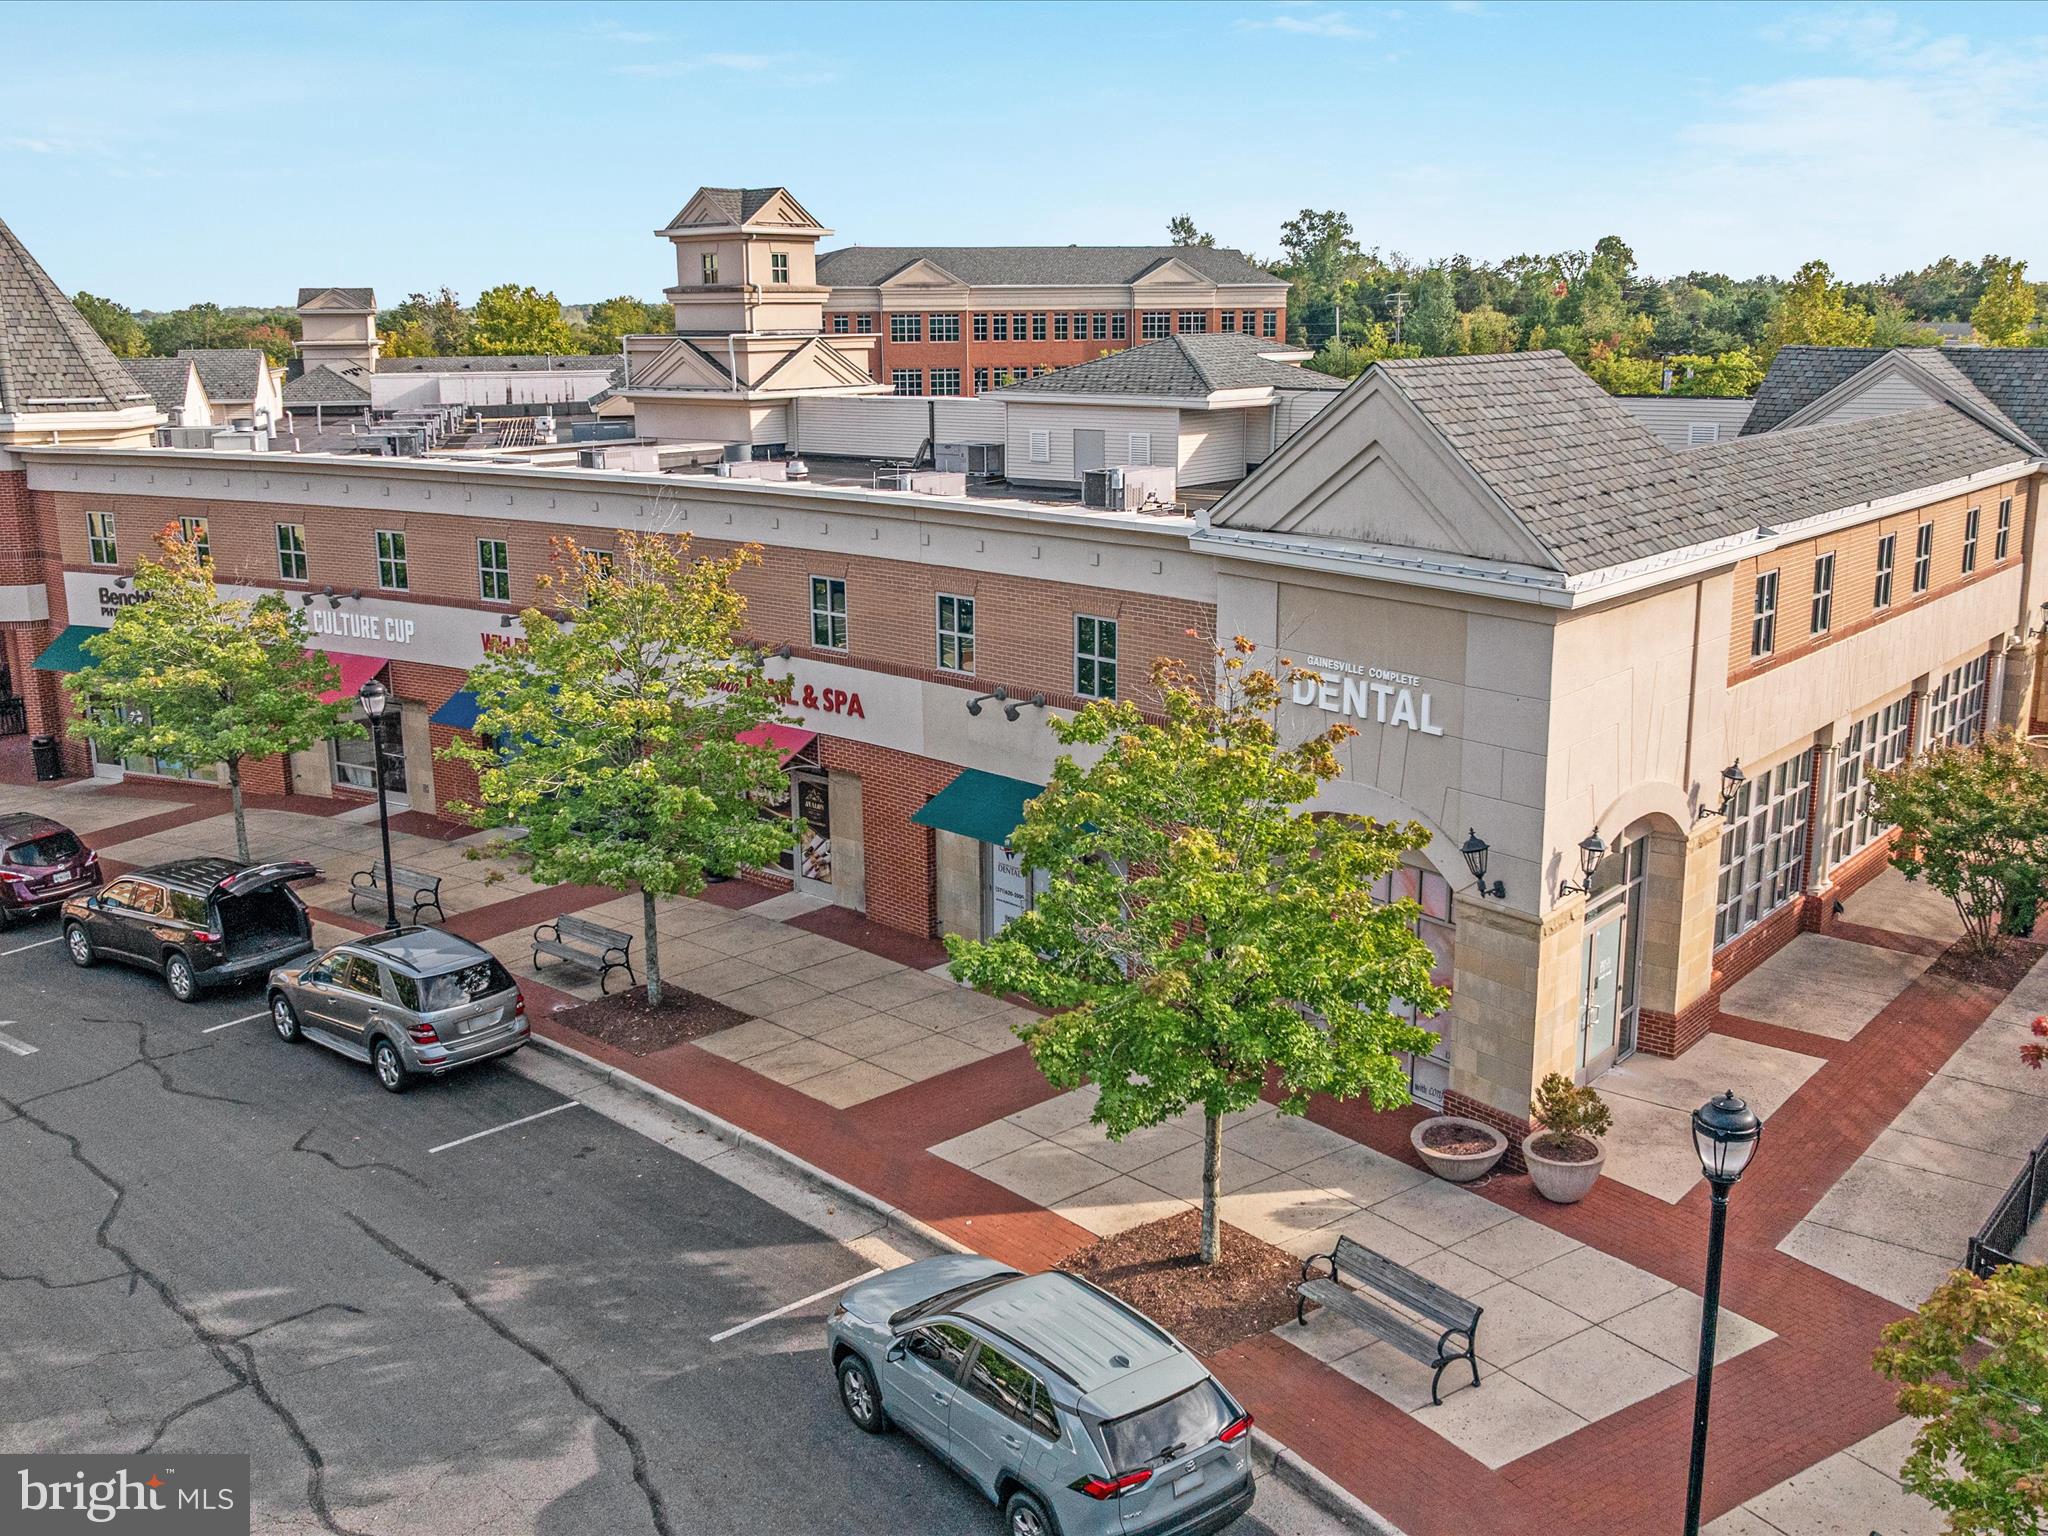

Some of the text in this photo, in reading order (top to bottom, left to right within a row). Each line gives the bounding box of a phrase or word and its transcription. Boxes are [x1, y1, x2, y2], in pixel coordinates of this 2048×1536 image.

[313, 609, 381, 640] CULTURE
[385, 617, 416, 644] CUP
[1307, 655, 1421, 687] GAINESVILLE COMPLETE
[802, 683, 820, 711] &
[822, 687, 866, 720] SPA
[1292, 671, 1445, 737] DENTAL
